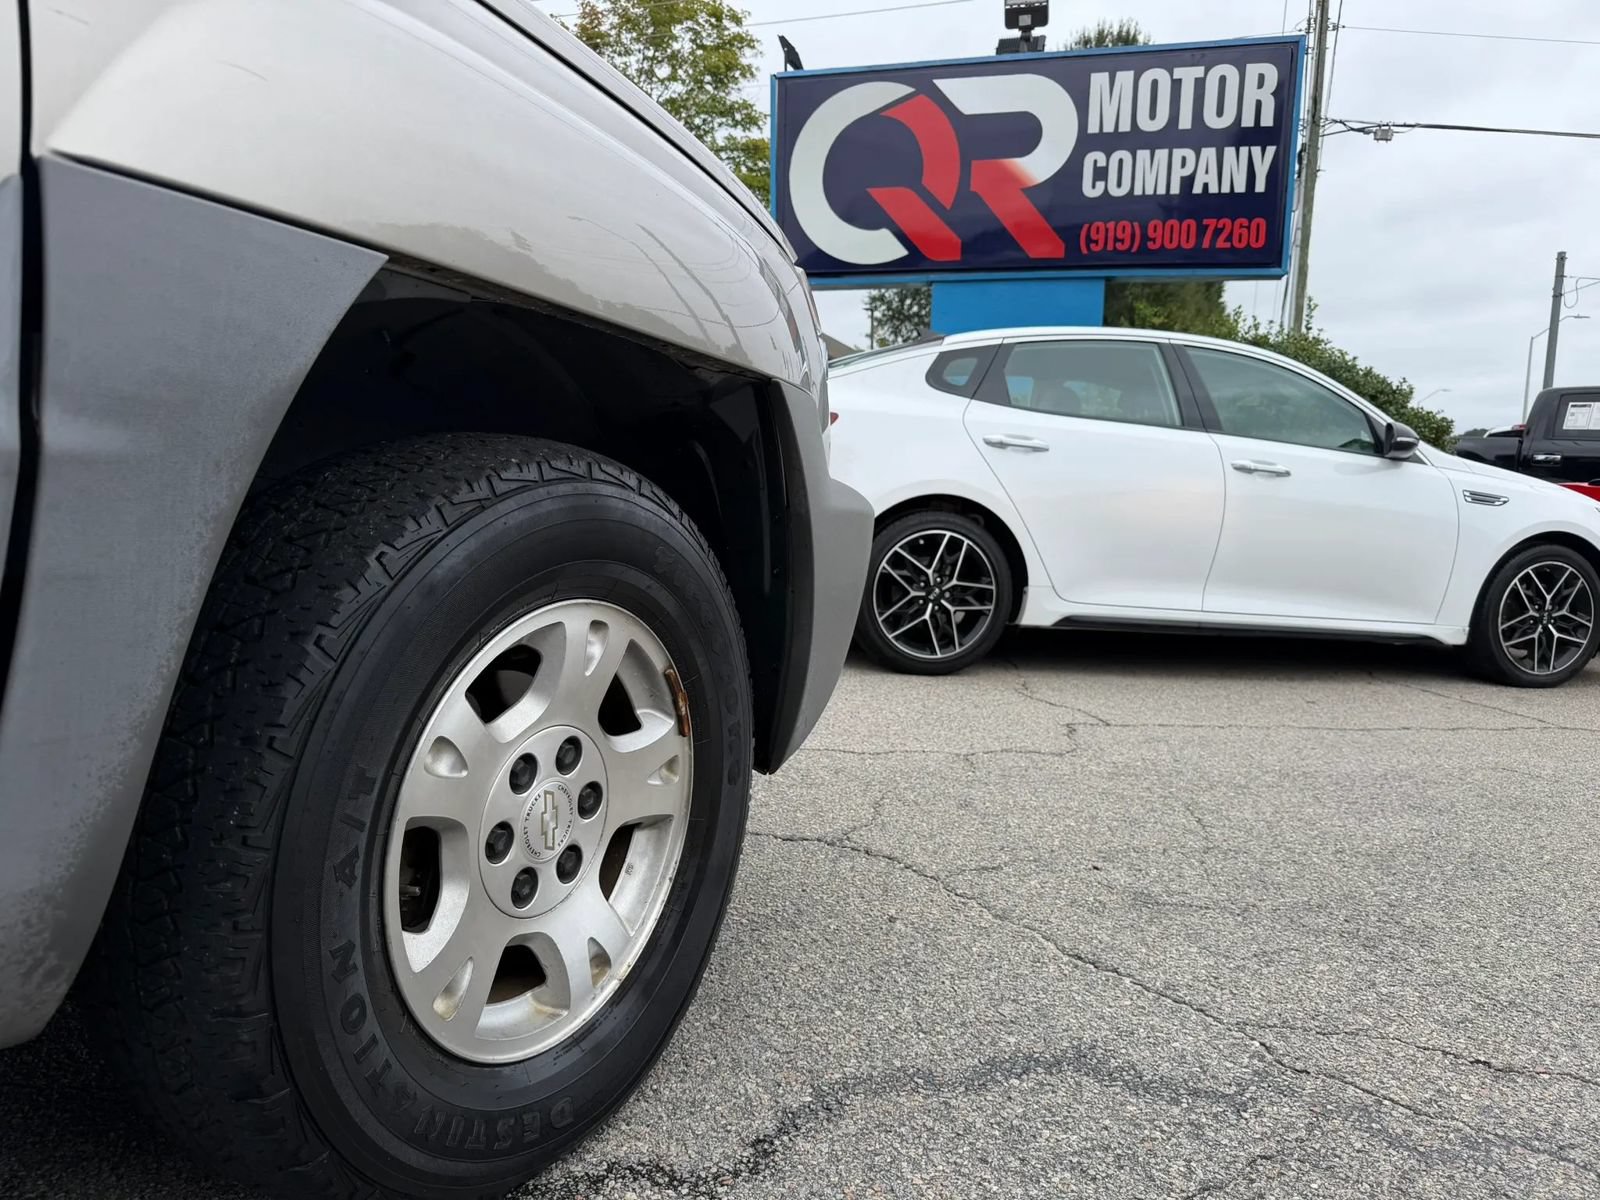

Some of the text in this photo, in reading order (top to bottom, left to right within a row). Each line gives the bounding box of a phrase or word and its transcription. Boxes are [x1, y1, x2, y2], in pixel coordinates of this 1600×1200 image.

[1087, 62, 1279, 135] MOTOR
[1081, 145, 1277, 198] COMPANY
[1079, 217, 1267, 254] (919) 900 7260
[523, 793, 541, 857] CHEVROLET TRUCKS
